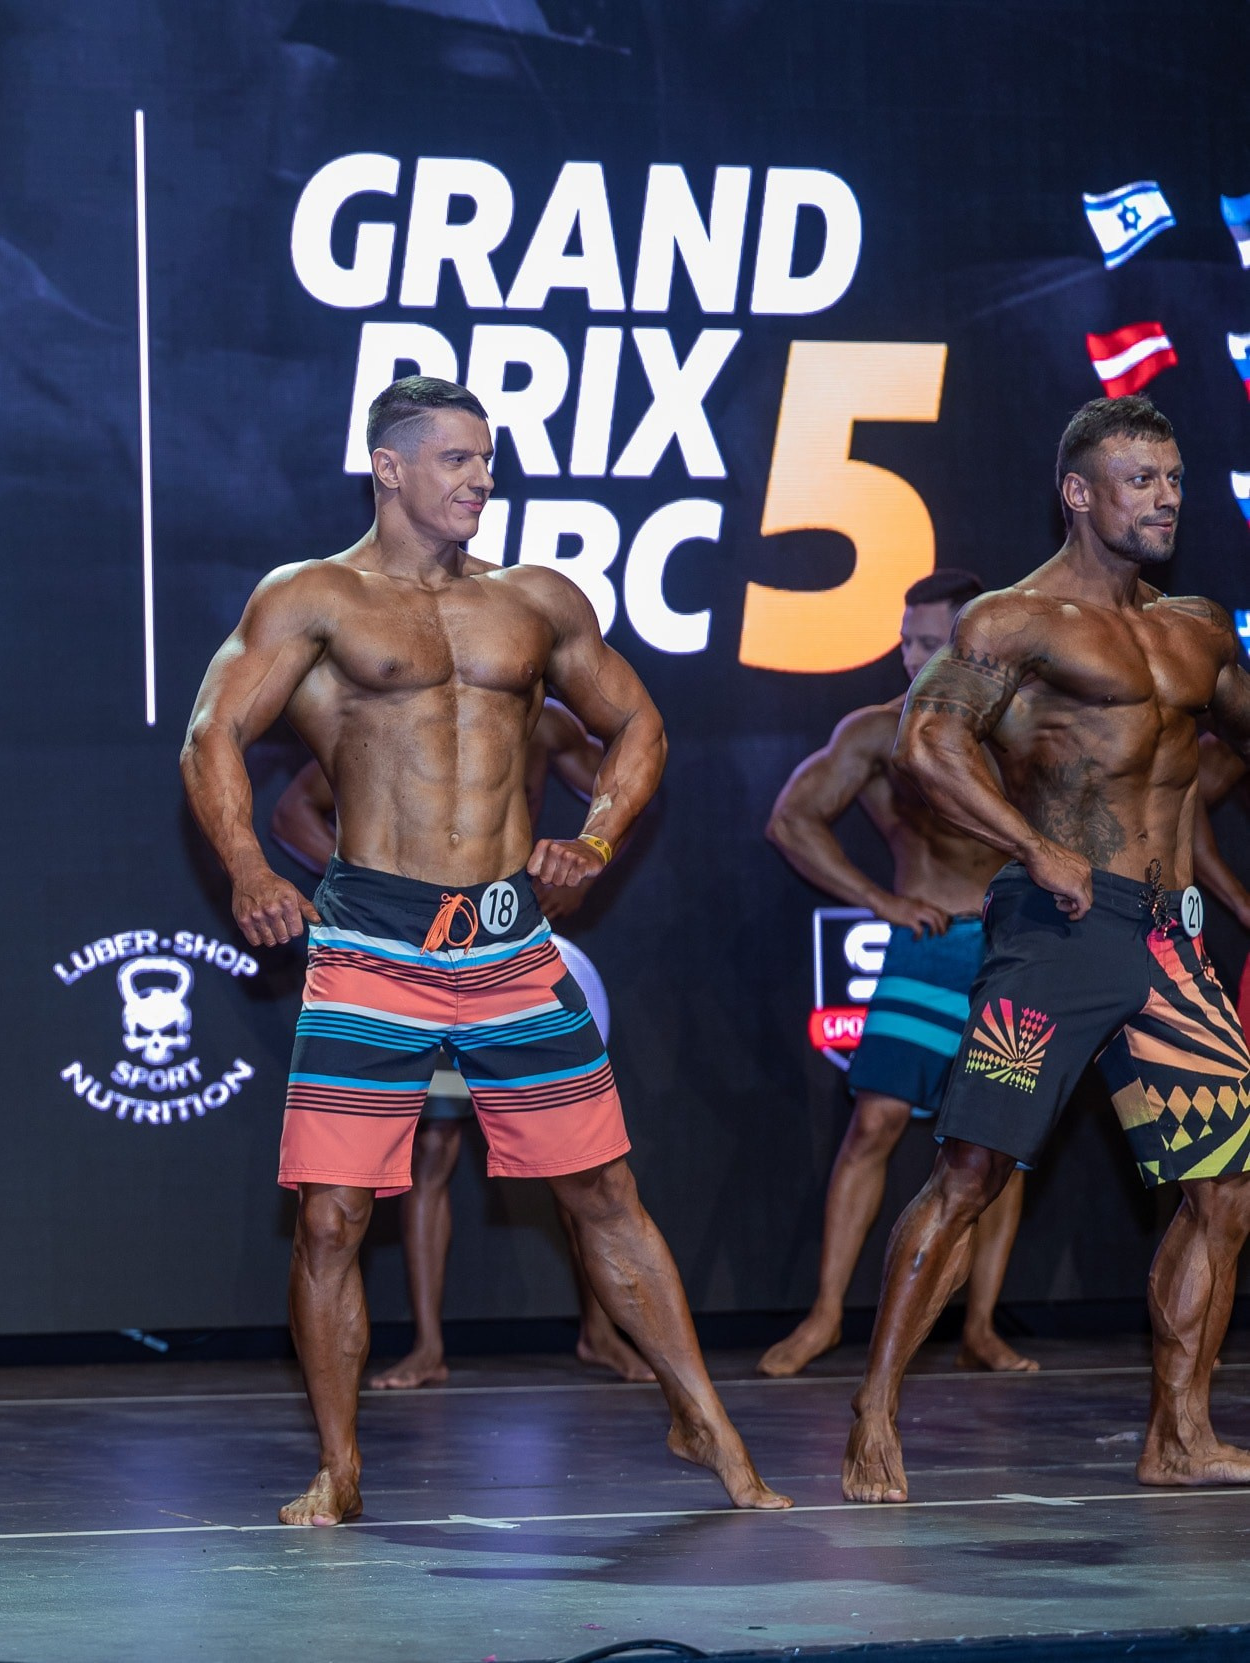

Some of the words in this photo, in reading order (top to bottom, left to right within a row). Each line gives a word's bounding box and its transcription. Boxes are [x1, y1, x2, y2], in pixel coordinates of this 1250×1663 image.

[290, 152, 862, 315] GRAND
[344, 321, 742, 479] PRIX
[738, 339, 948, 674] 5
[488, 888, 514, 927] 18
[1187, 895, 1201, 929] 21
[823, 1015, 864, 1040] SPO
[60, 1057, 255, 1124] NUTRITION
[110, 1056, 201, 1092] SPORT
